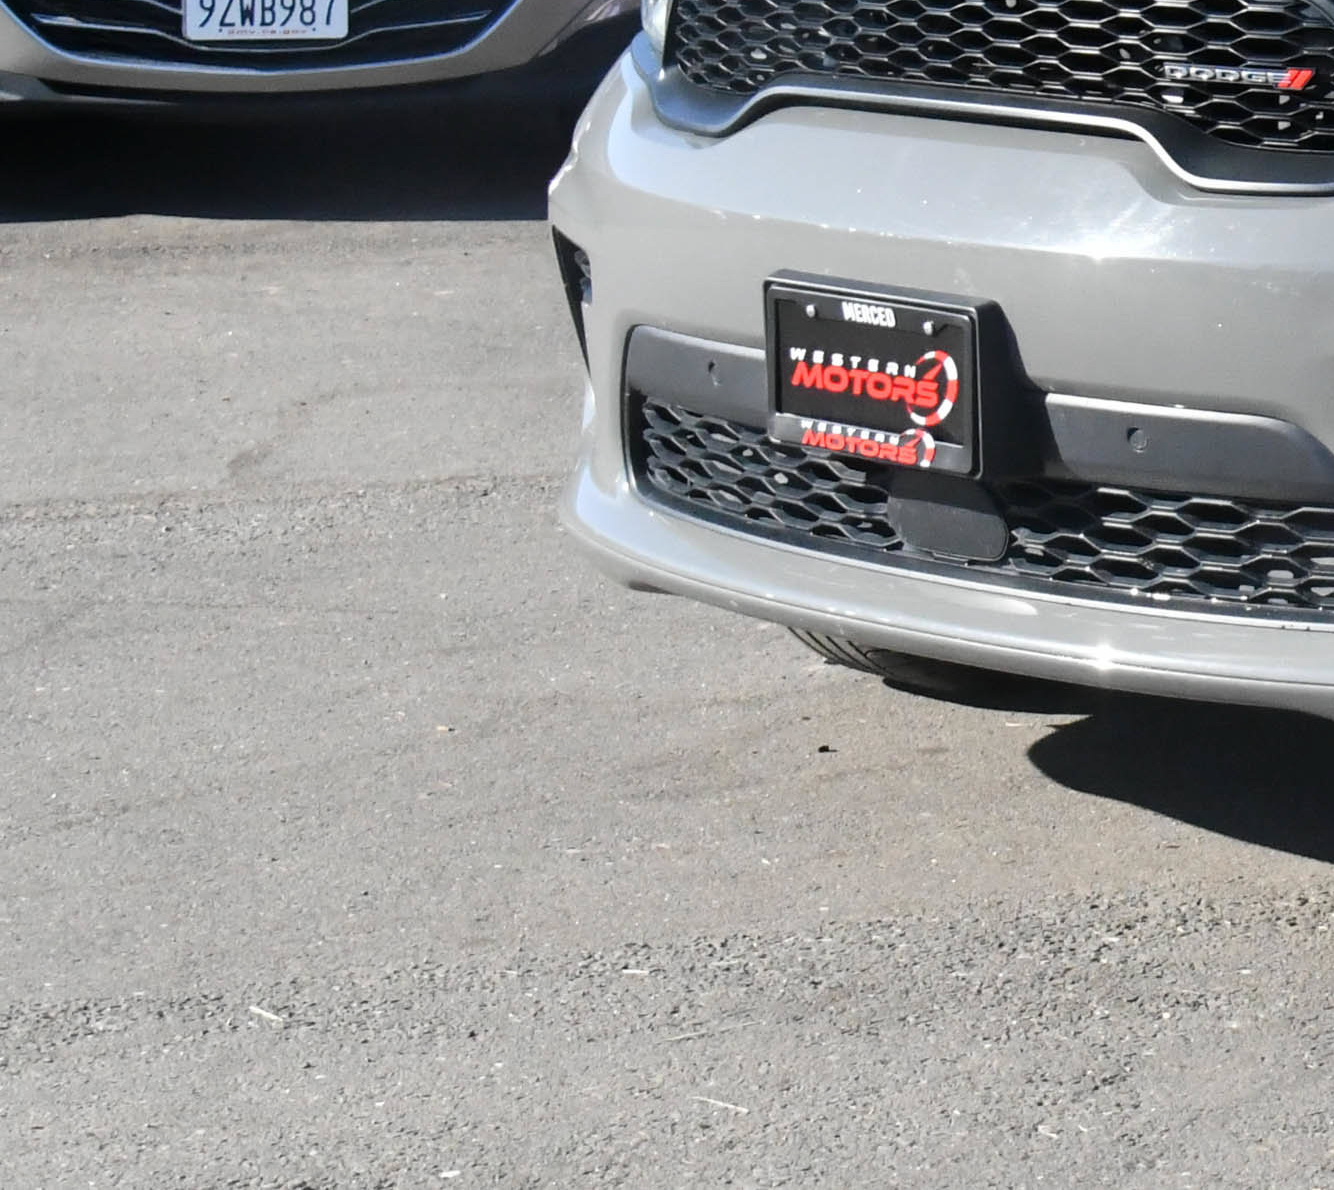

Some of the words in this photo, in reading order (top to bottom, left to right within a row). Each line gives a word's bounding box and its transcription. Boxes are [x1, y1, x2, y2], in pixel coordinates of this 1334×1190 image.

[1163, 63, 1292, 86] DODGE
[841, 300, 896, 329] MERCED
[790, 346, 917, 379] WESTERN
[791, 360, 940, 409] MOTORS
[800, 419, 900, 446] WESTERN
[802, 428, 917, 466] MOTORS
